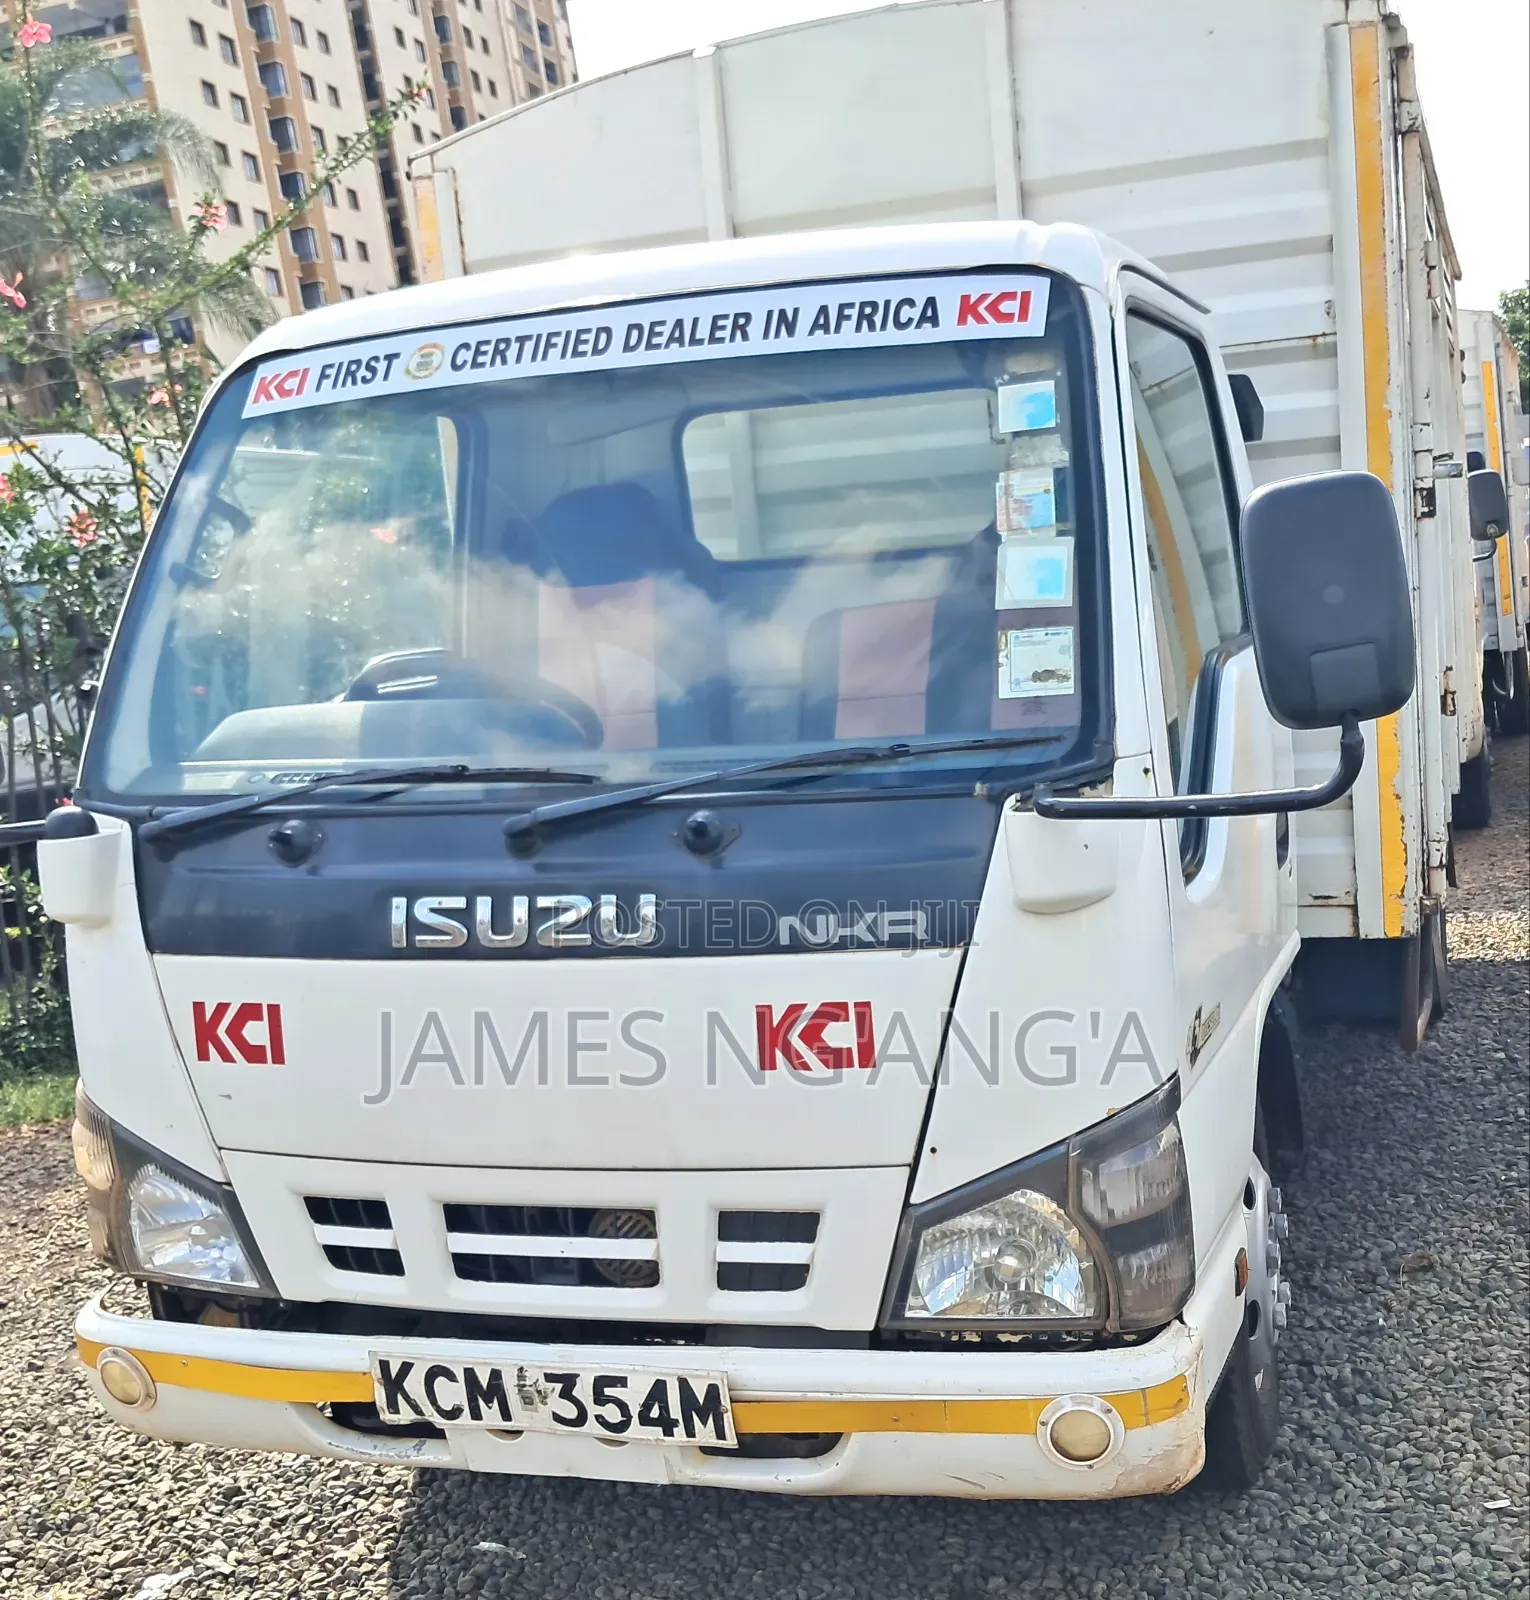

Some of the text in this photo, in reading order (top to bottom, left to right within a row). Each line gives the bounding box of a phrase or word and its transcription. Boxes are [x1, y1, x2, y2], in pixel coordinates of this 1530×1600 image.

[252, 368, 311, 405] KCI
[315, 352, 401, 393] FIRST
[450, 325, 613, 372] CERTIFIED
[622, 312, 752, 353] DEALER
[763, 307, 800, 340] IN
[809, 296, 940, 336] AFRICA
[956, 290, 1032, 326] KCI
[391, 894, 656, 949] ISUZU
[780, 910, 928, 945] NKR
[192, 1001, 285, 1065] KCI
[755, 1001, 876, 1071] KCI
[378, 1358, 726, 1440] KCM 354M
